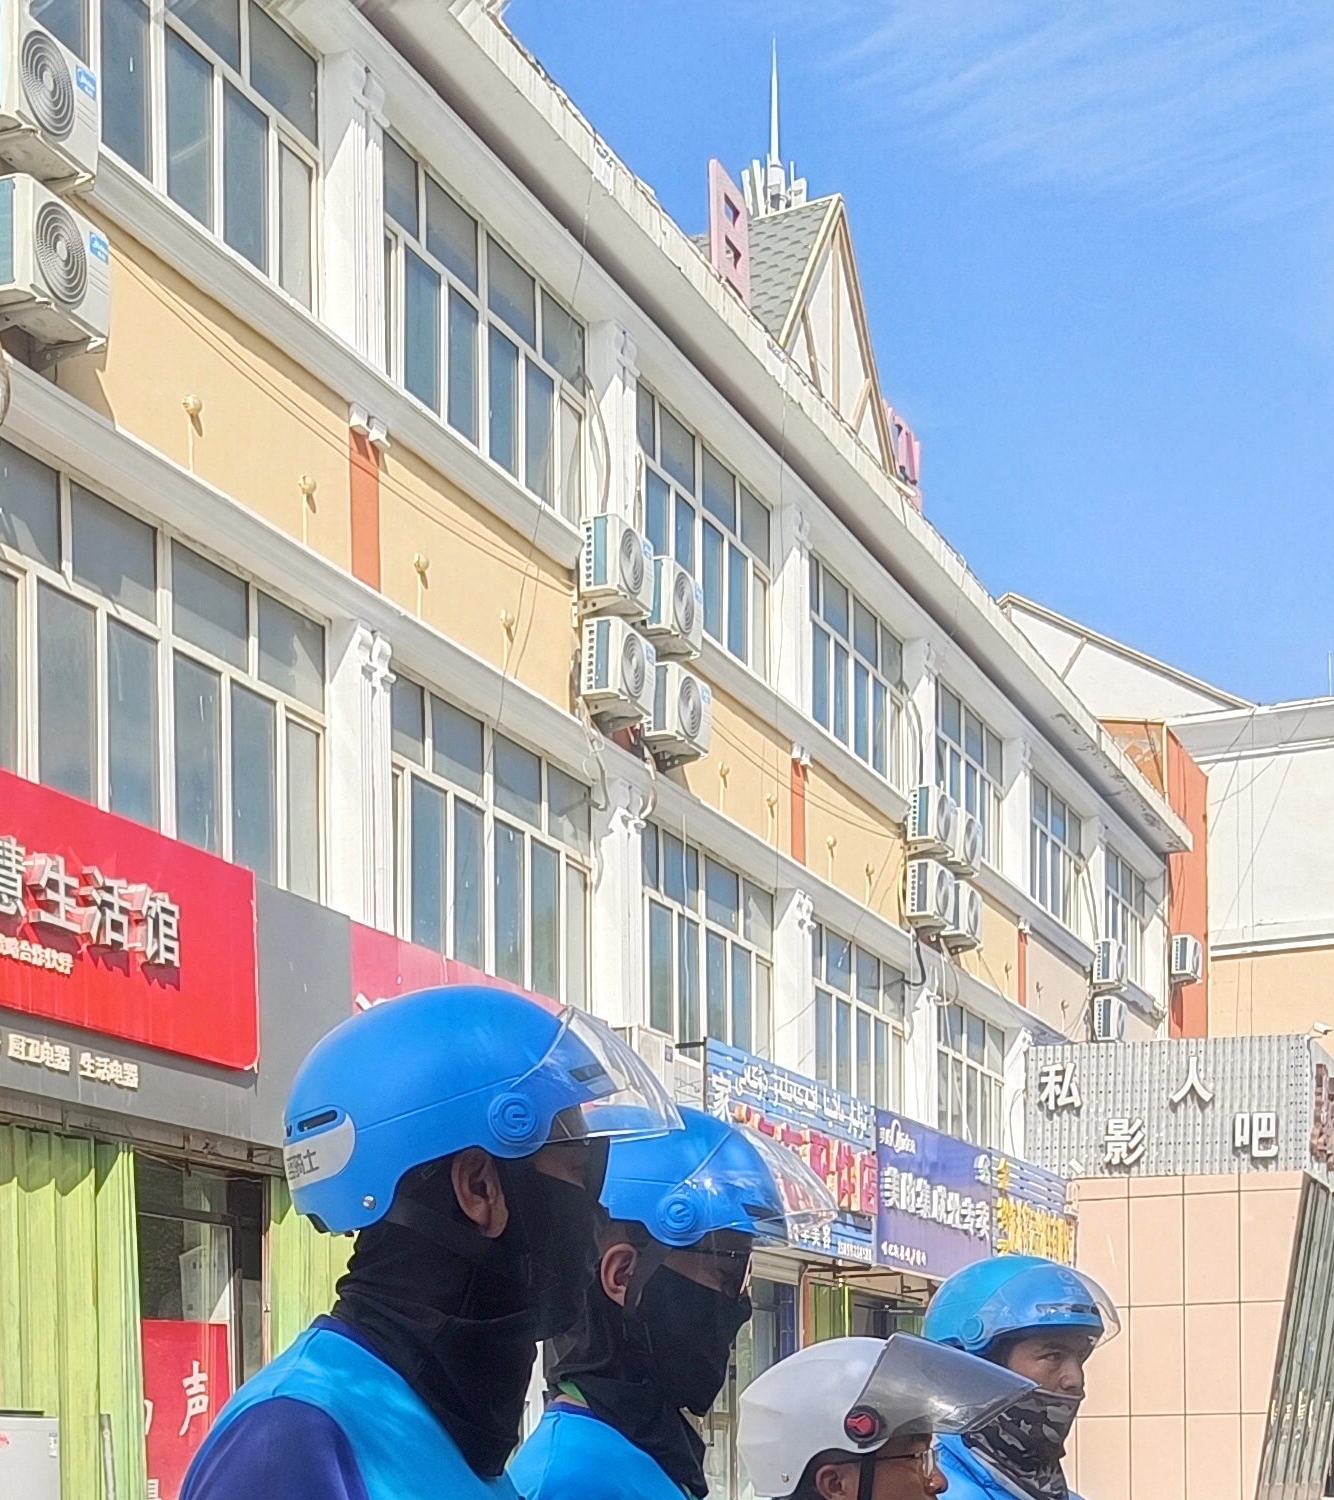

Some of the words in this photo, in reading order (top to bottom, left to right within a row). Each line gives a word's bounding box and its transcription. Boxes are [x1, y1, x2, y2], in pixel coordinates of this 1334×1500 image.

[7, 1032, 71, 1072] 厨卫电器
[77, 1051, 140, 1089] 生活电器
